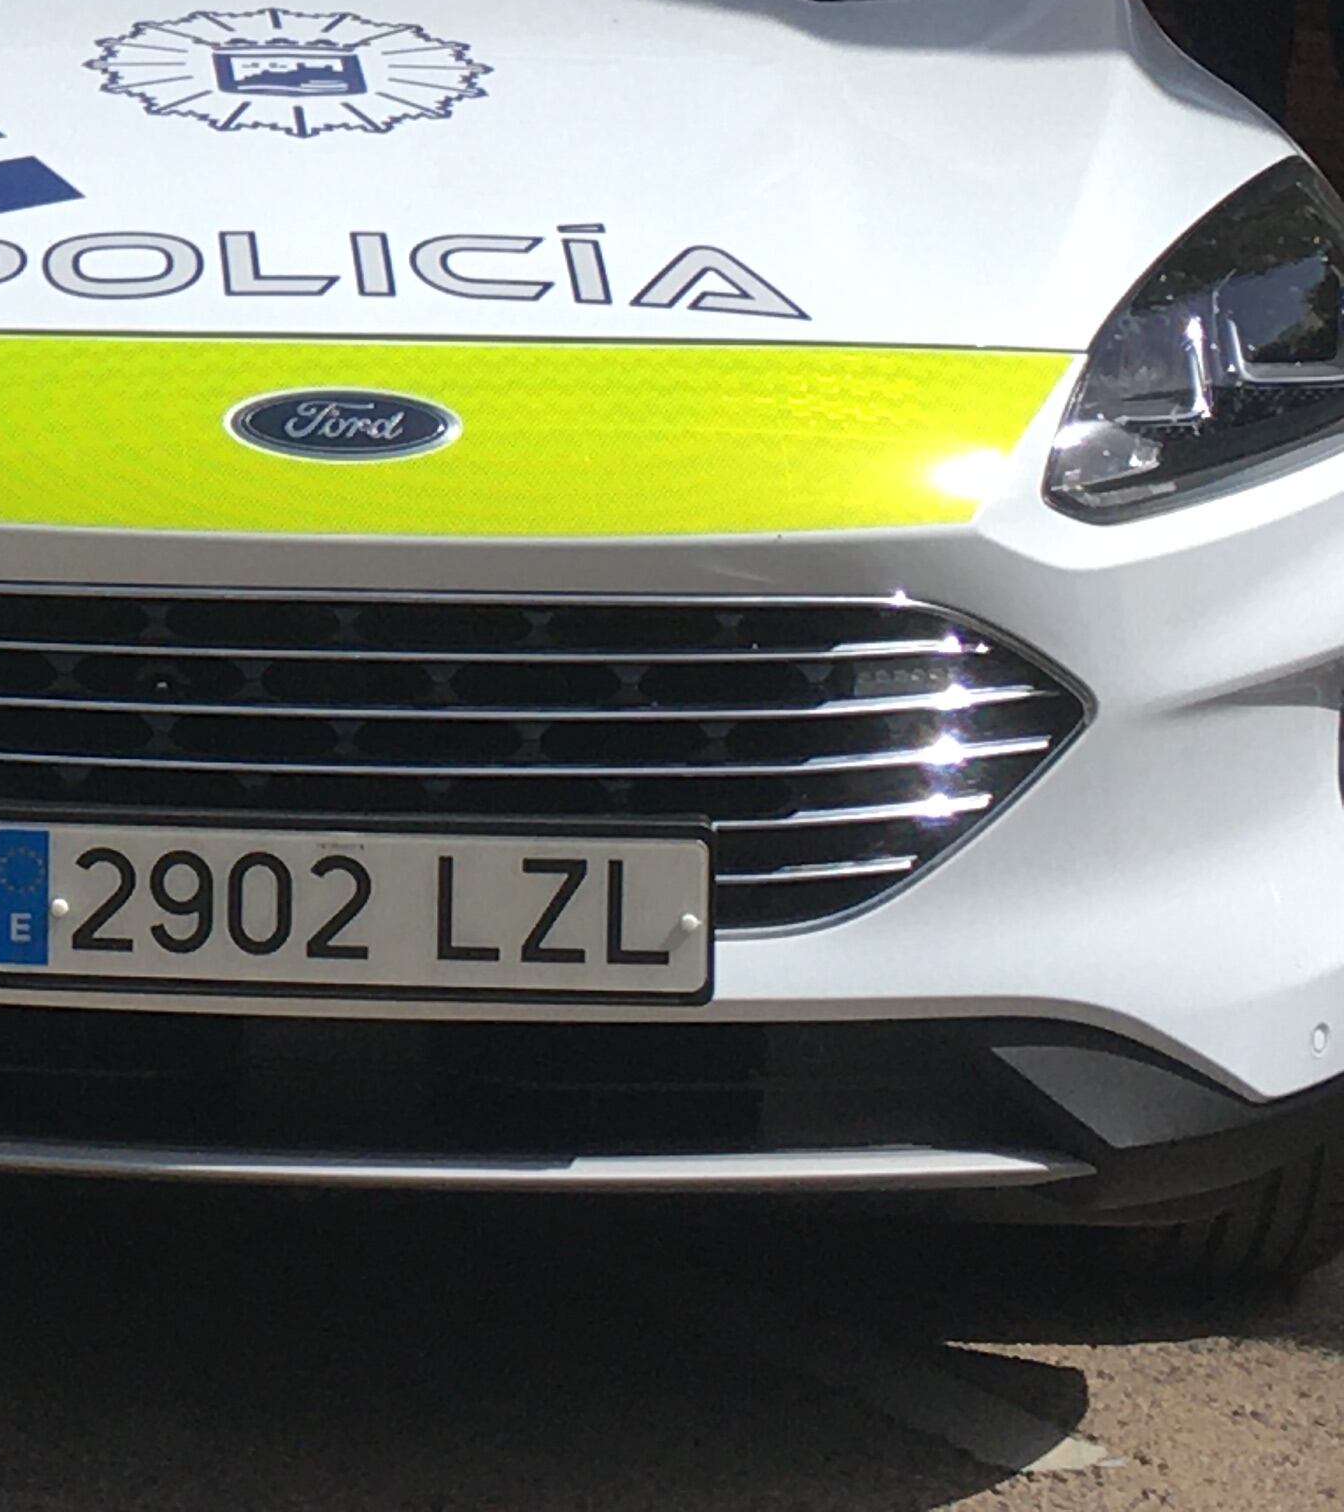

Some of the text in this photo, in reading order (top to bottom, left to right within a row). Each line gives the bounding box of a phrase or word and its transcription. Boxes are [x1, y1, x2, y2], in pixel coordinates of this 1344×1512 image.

[283, 399, 406, 440] Ford
[71, 846, 672, 966] 2902 LZL
[10, 913, 32, 942] E
